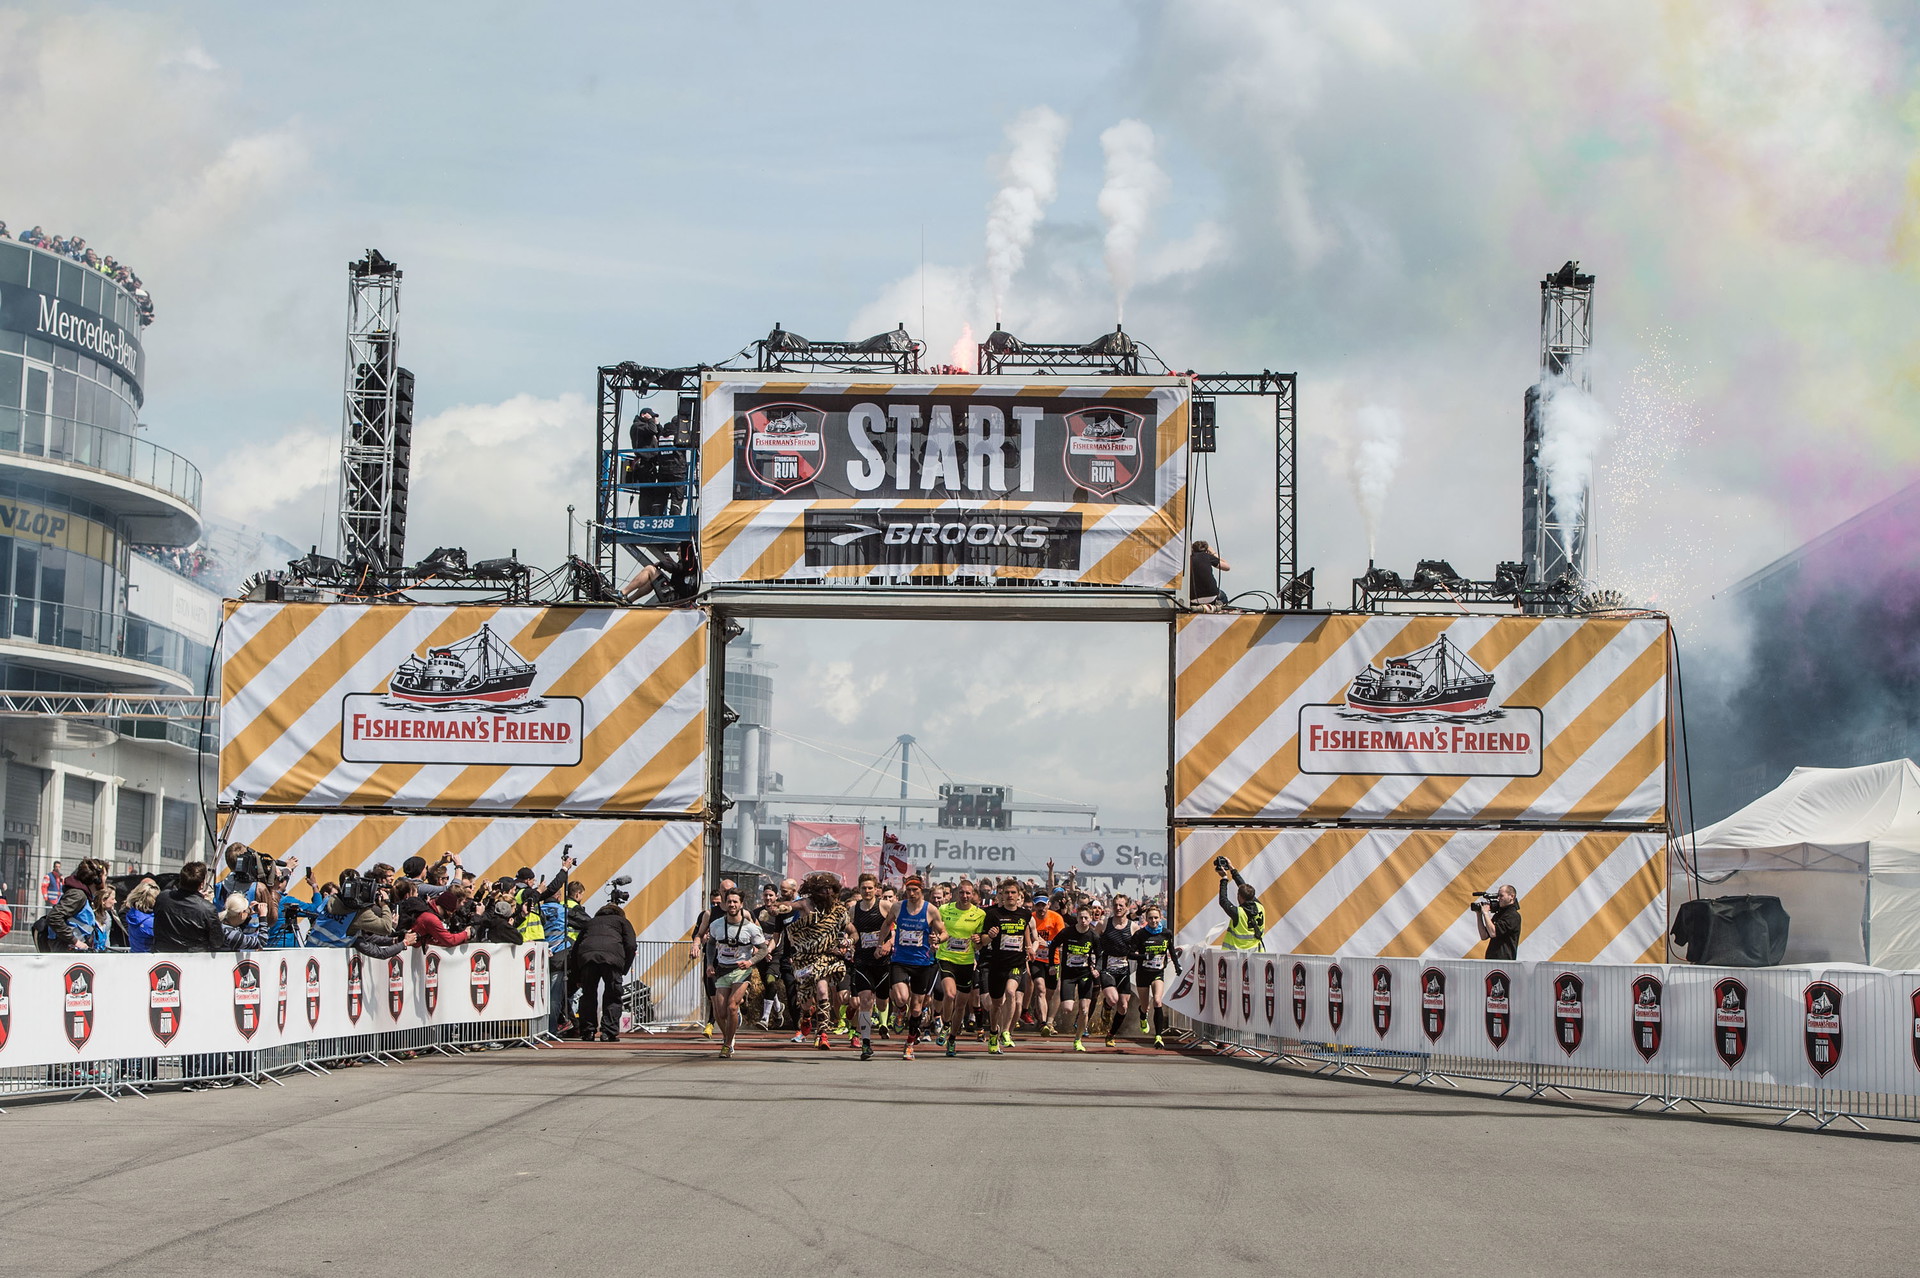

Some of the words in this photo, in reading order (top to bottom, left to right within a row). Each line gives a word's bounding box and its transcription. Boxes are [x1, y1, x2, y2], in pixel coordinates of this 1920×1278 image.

[37, 294, 137, 375] Mercedes-Benz
[755, 438, 794, 446] FISHERMAN'S
[794, 438, 816, 446] FRIEND
[846, 402, 1044, 493] START
[1072, 442, 1111, 450] FISHERMAN'S
[1111, 442, 1133, 451] FRIEND
[774, 462, 798, 478] RUN
[1091, 467, 1115, 483] RUN
[633, 519, 645, 529] GS
[652, 518, 675, 529] 3268
[883, 522, 1050, 549] BROOKS
[352, 713, 489, 742] FISHERMAN'S
[493, 715, 571, 743] FRIEND
[1309, 724, 1449, 752] FISHERMAN'S
[1451, 726, 1531, 754] FRIEND
[934, 838, 1016, 862] Fahren
